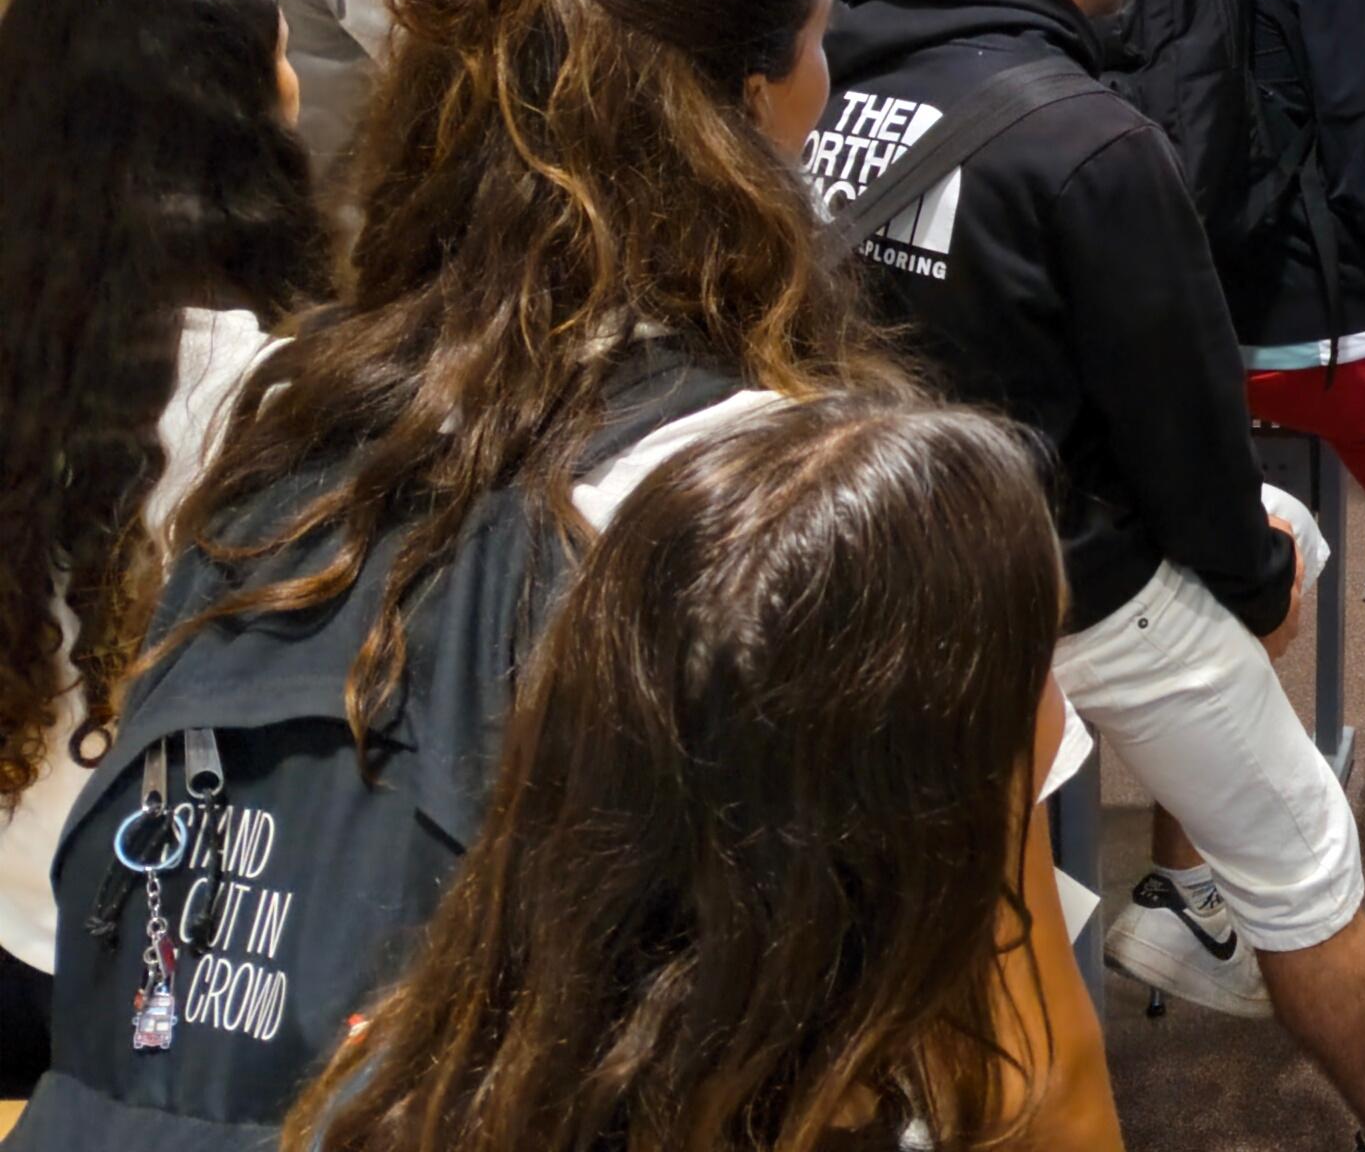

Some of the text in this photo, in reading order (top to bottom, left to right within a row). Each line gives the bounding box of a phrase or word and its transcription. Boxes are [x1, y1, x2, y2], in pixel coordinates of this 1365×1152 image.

[835, 90, 917, 143] THE
[800, 129, 896, 184] ORTH
[858, 239, 947, 280] PLORING
[247, 890, 293, 958] IN
[185, 953, 288, 1041] CROWD
